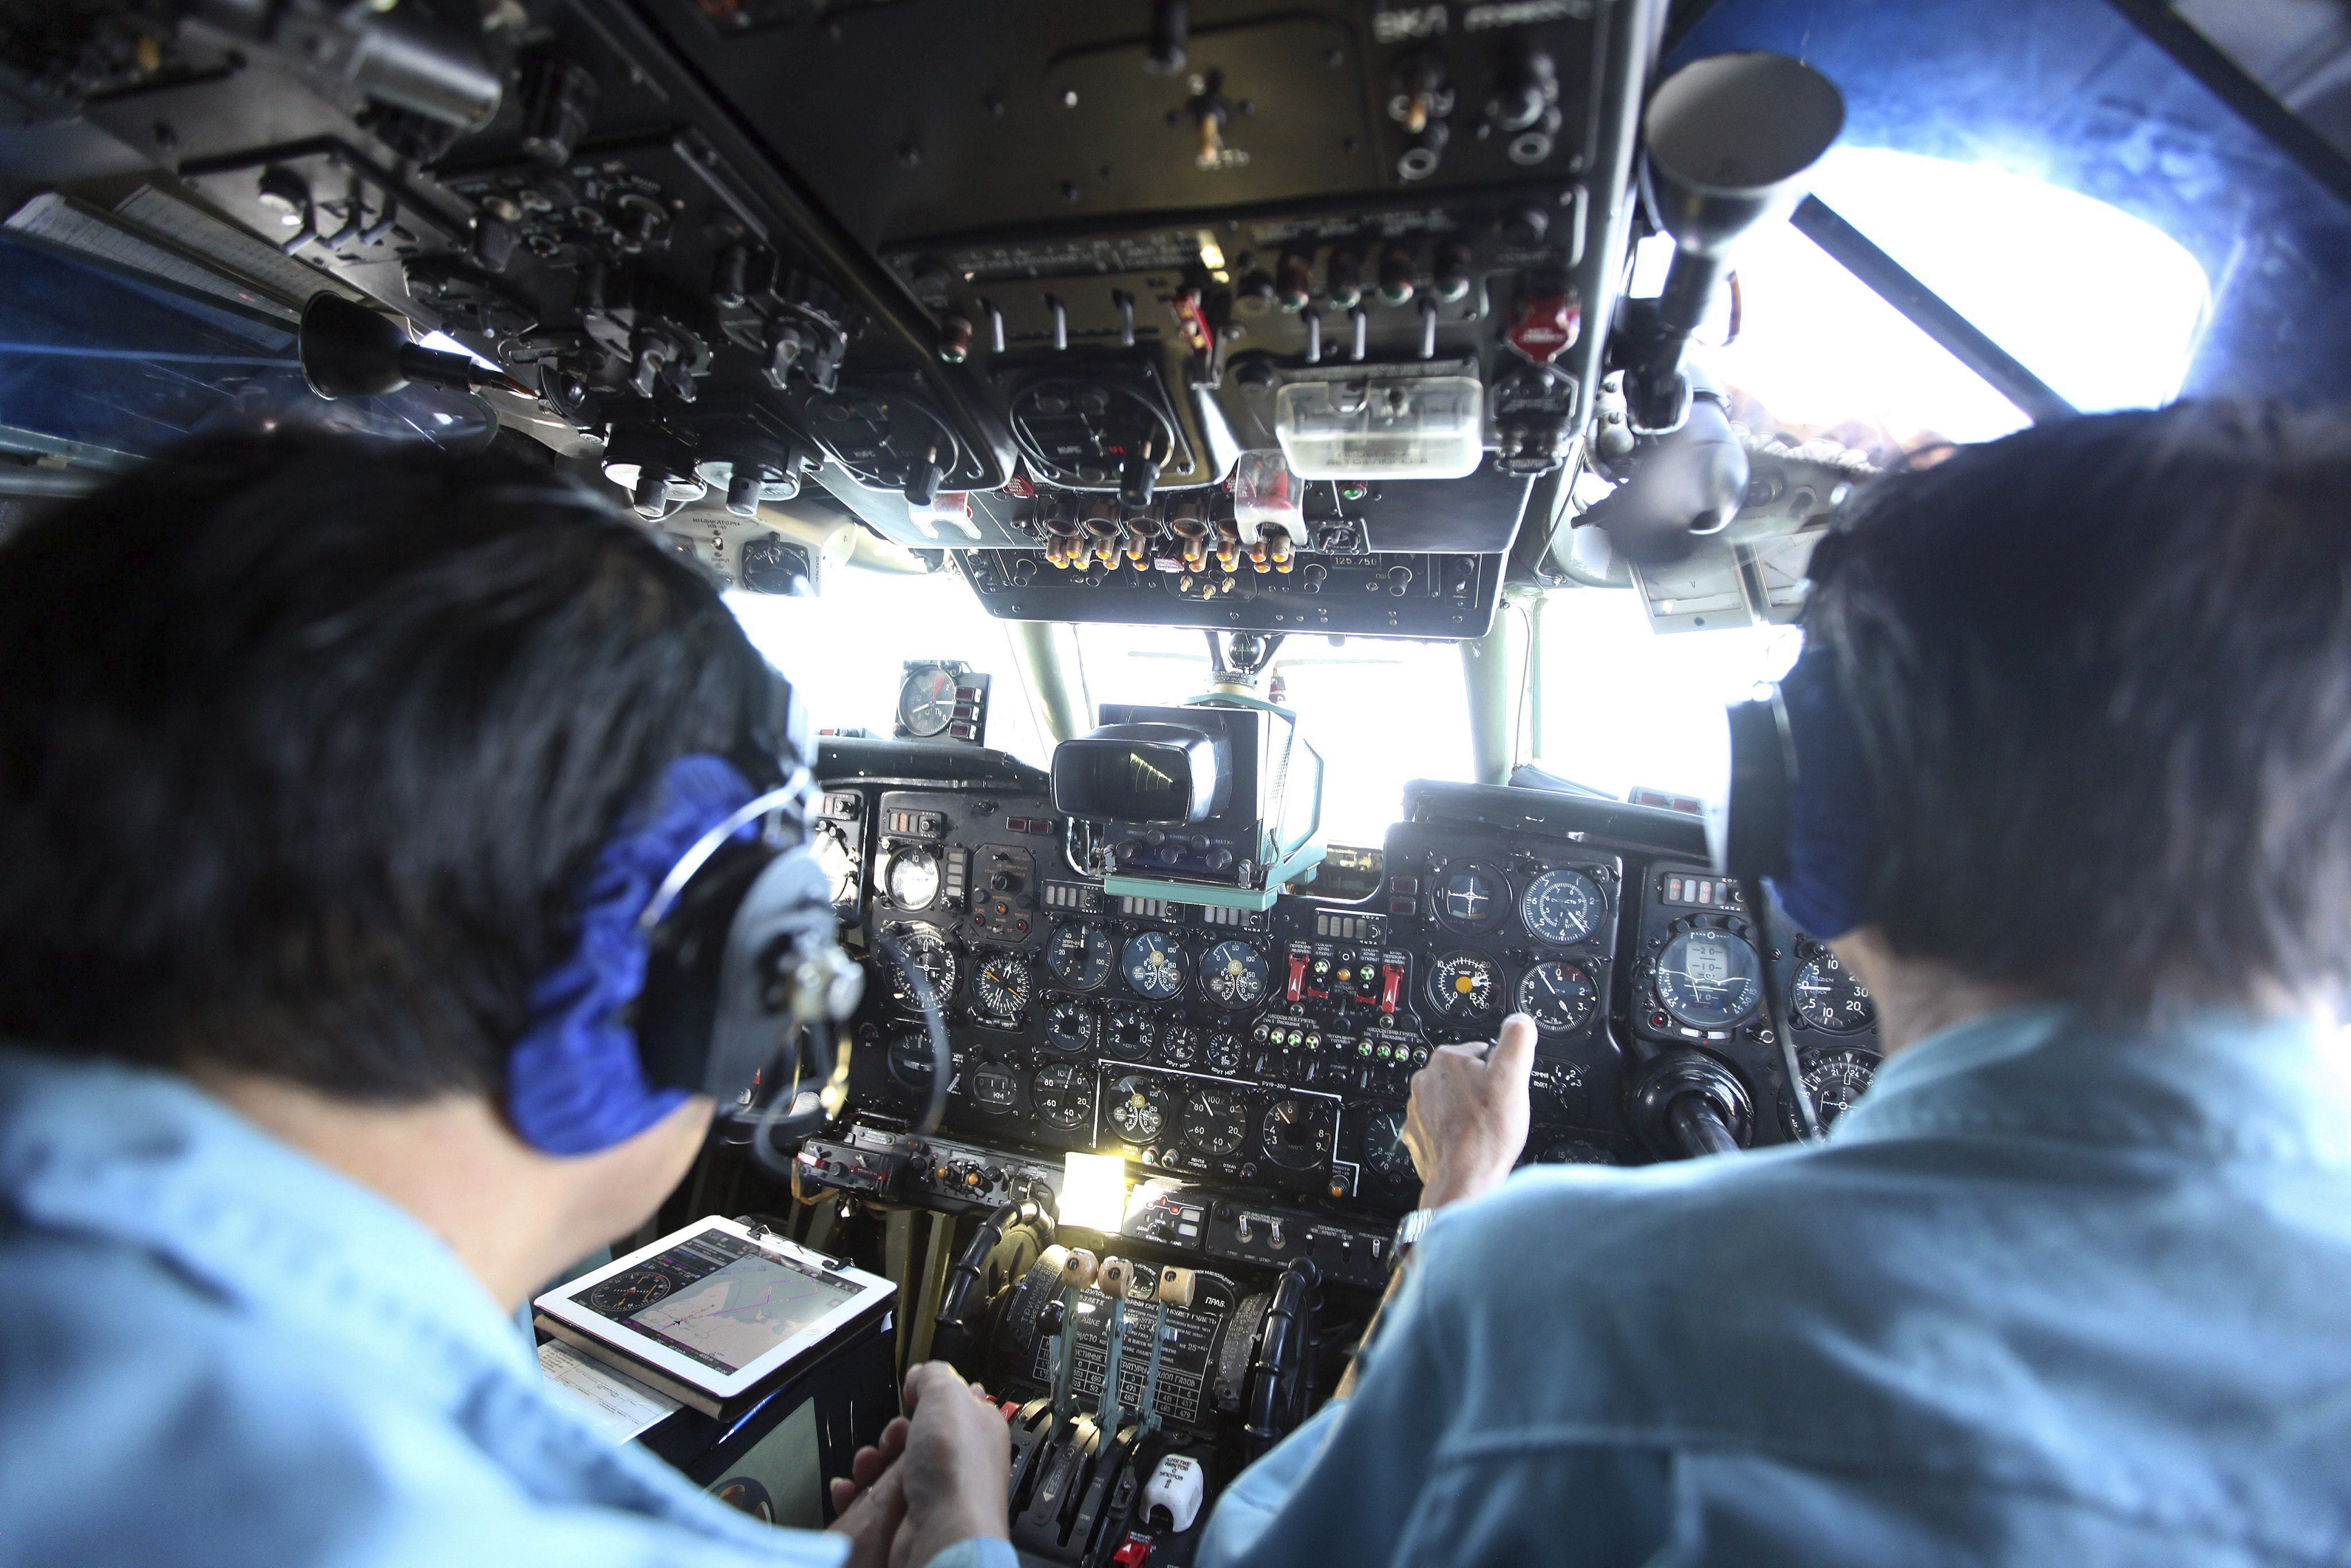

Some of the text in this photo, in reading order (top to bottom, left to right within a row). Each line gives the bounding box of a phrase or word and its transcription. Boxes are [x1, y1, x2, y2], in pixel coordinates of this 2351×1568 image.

[1828, 960, 1838, 969] 10
[1813, 966, 1819, 975] 5
[1854, 987, 1868, 997] 30
[1578, 1003, 1584, 1011] 3
[1809, 999, 1815, 1008] 5
[1846, 1001, 1861, 1011] 20
[1823, 1007, 1833, 1017] 10
[1115, 1034, 1119, 1042] 2
[1140, 1035, 1147, 1043] 10
[1175, 1376, 1195, 1387] ГАЗОВ
[1090, 1385, 1099, 1393] 512
